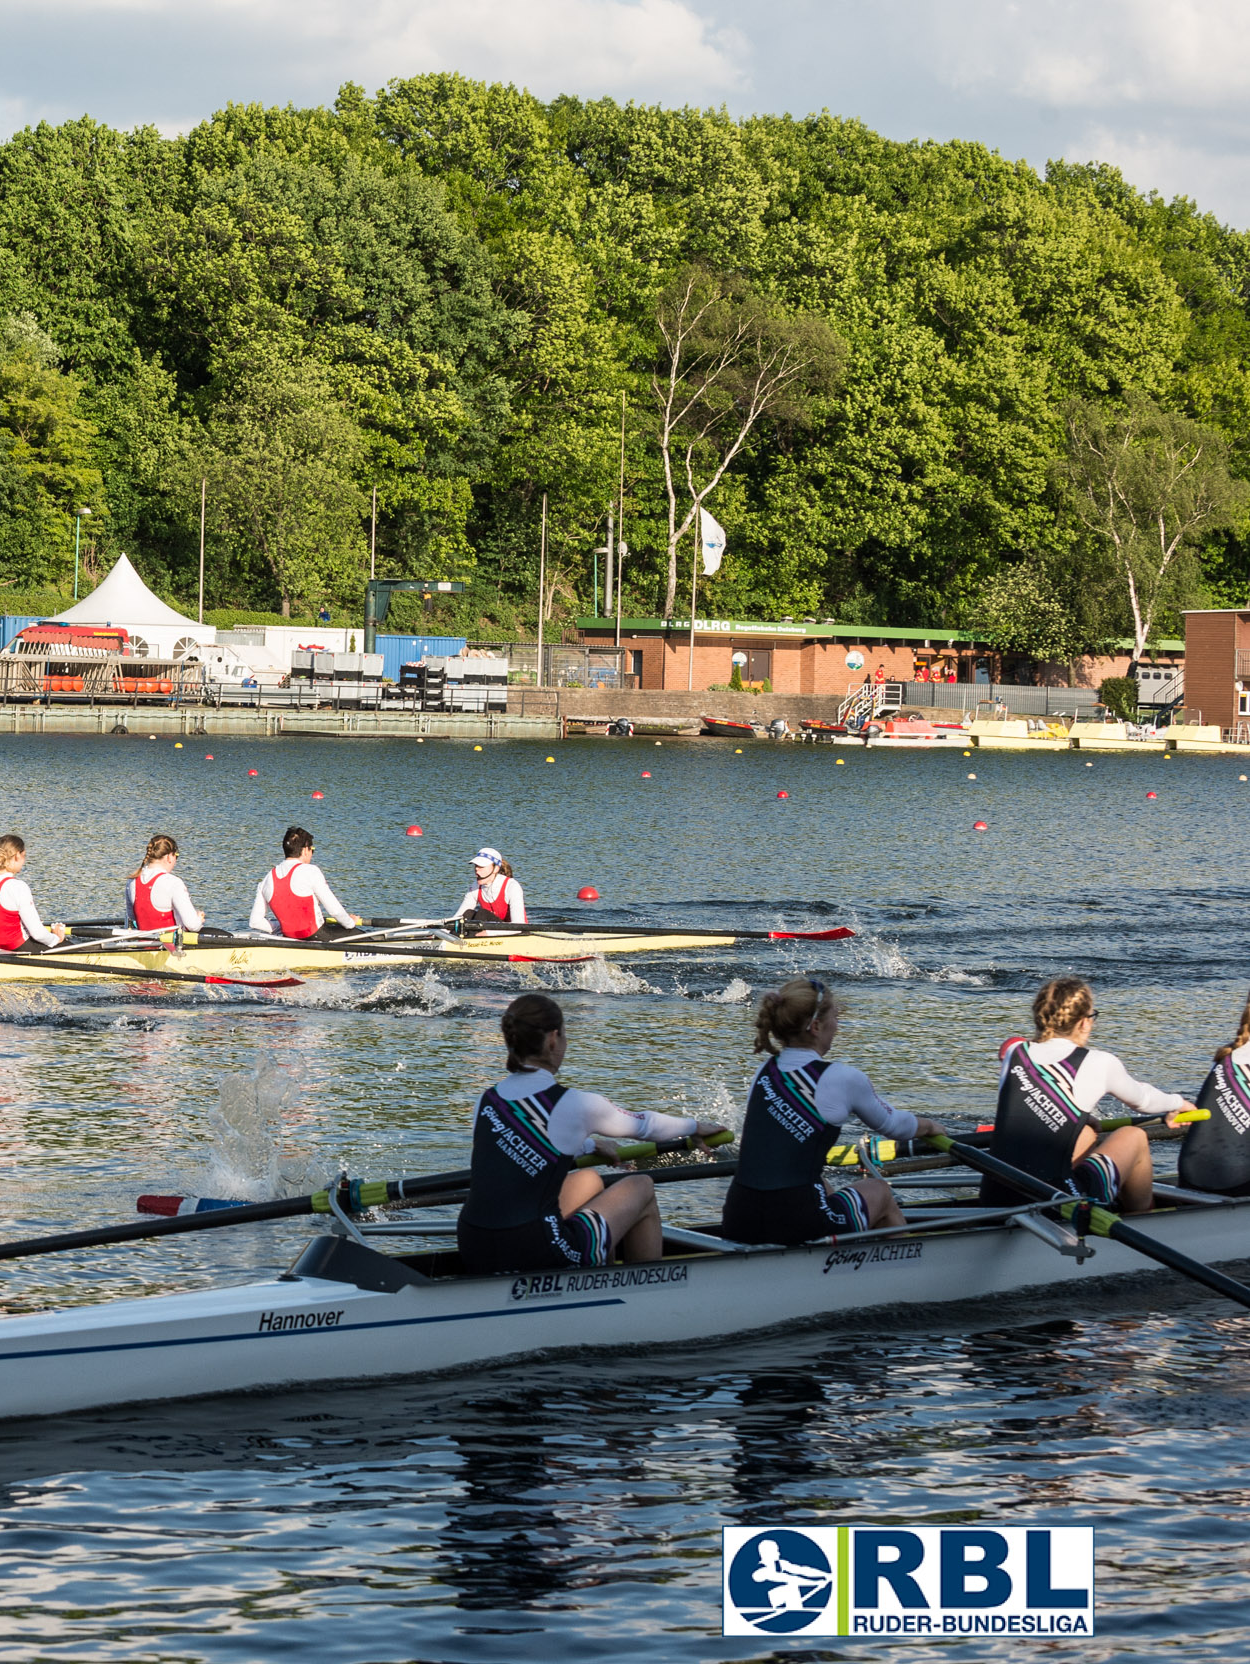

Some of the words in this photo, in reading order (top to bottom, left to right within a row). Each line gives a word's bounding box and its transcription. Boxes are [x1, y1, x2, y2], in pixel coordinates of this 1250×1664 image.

[693, 620, 731, 631] DLRG
[767, 1105, 806, 1144] HANNOVER
[1024, 1096, 1060, 1133] HANNOVER
[496, 1138, 539, 1178] HANNOVER
[529, 1274, 563, 1293] RBL
[566, 1266, 688, 1292] RUDER-BUNDESLIGA
[258, 1311, 345, 1332] Hannover
